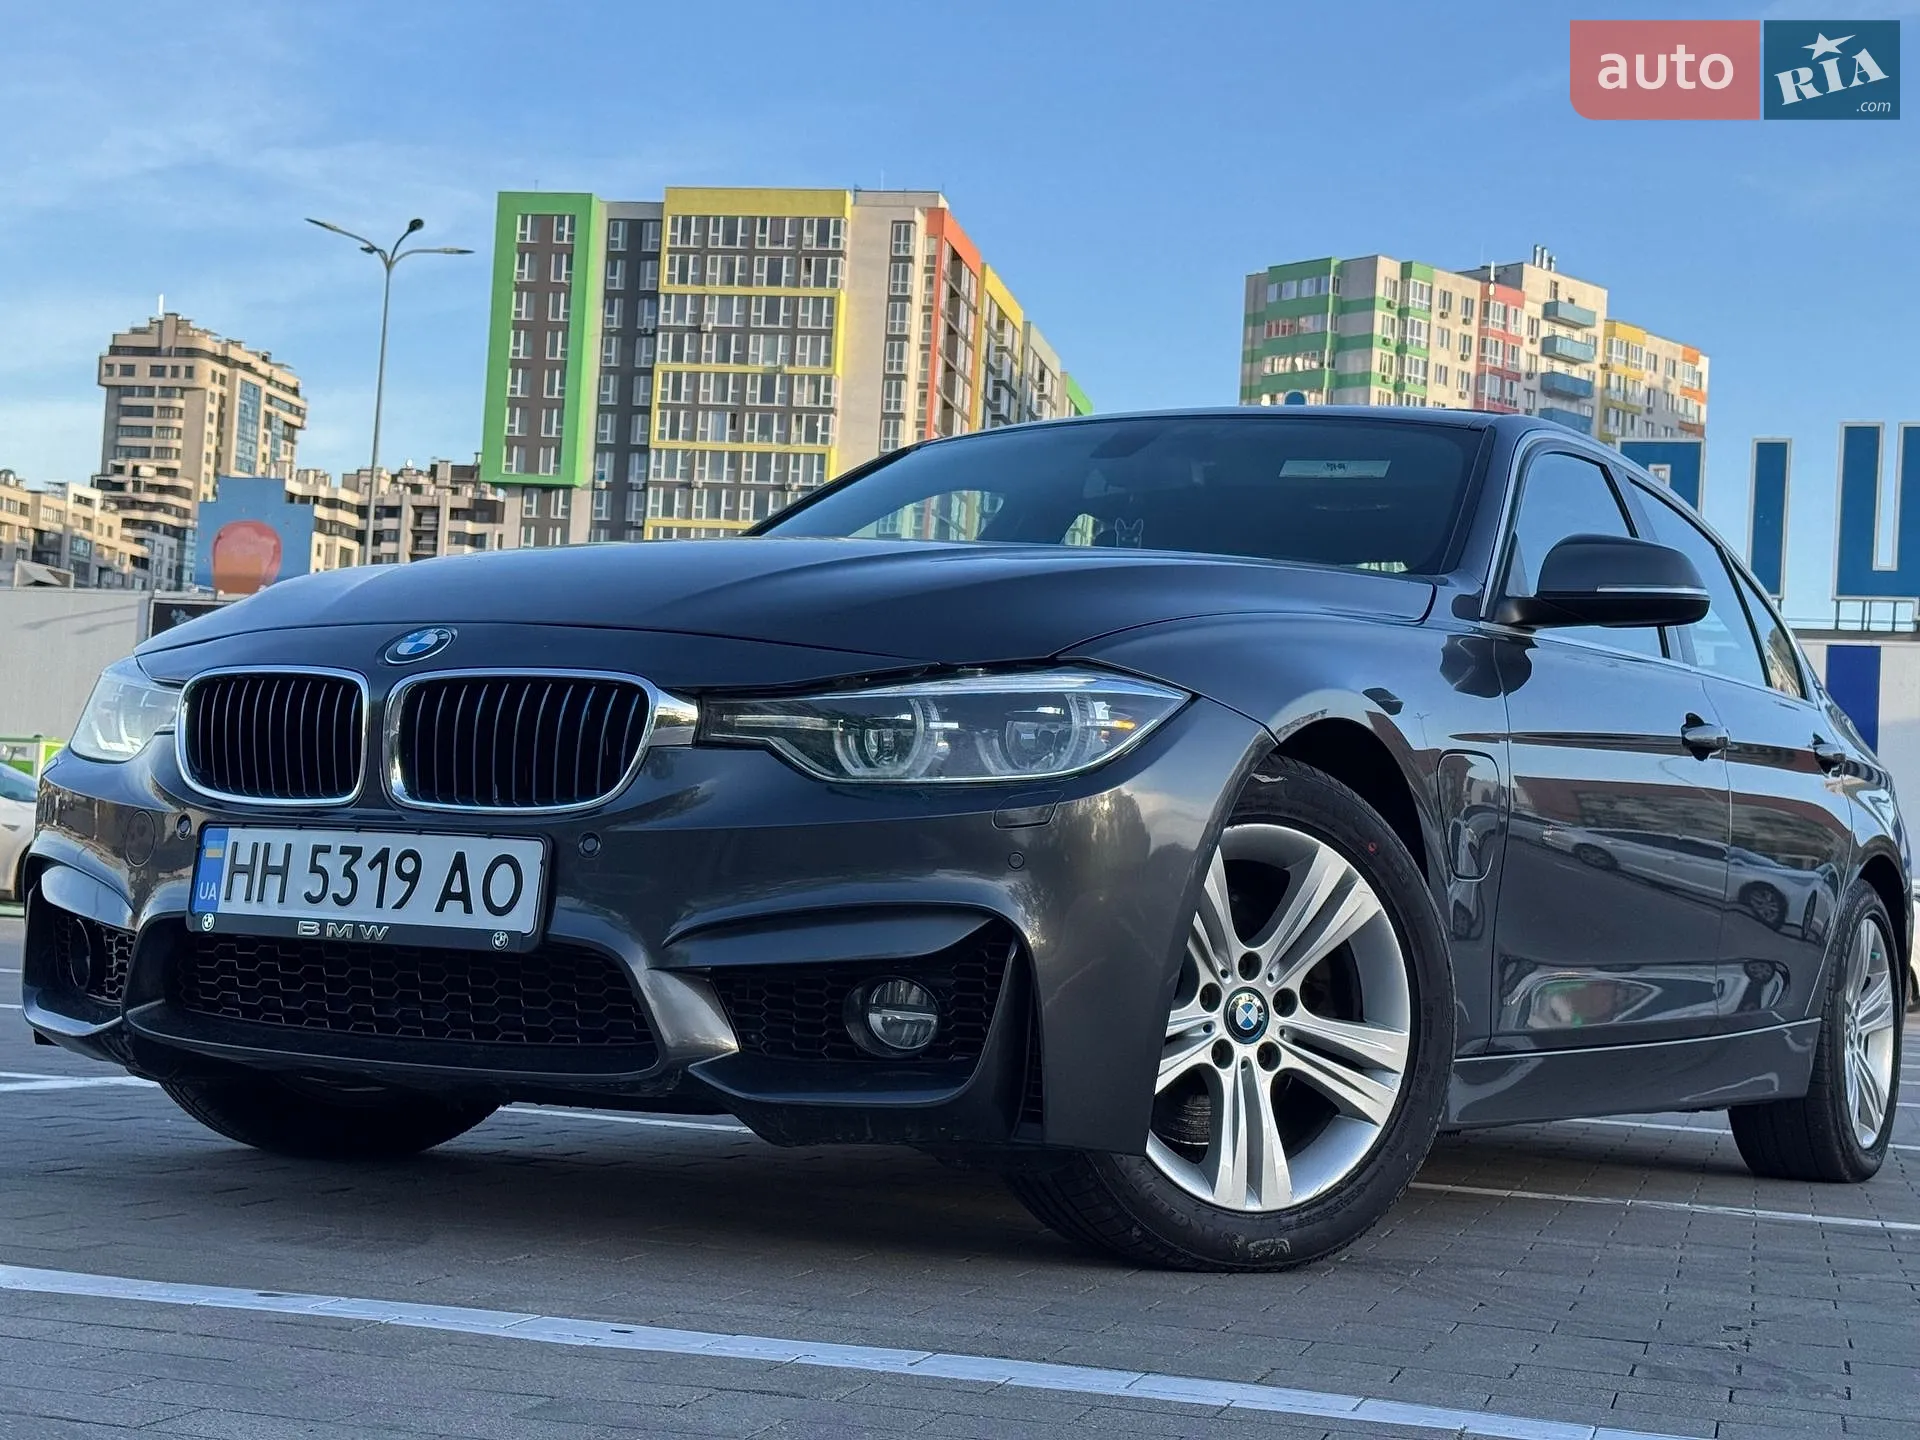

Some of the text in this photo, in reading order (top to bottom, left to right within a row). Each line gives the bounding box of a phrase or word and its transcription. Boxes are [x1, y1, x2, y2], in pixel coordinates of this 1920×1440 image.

[224, 841, 525, 917] HH 5319 AO
[200, 881, 217, 901] UA
[297, 920, 390, 941] BMW
